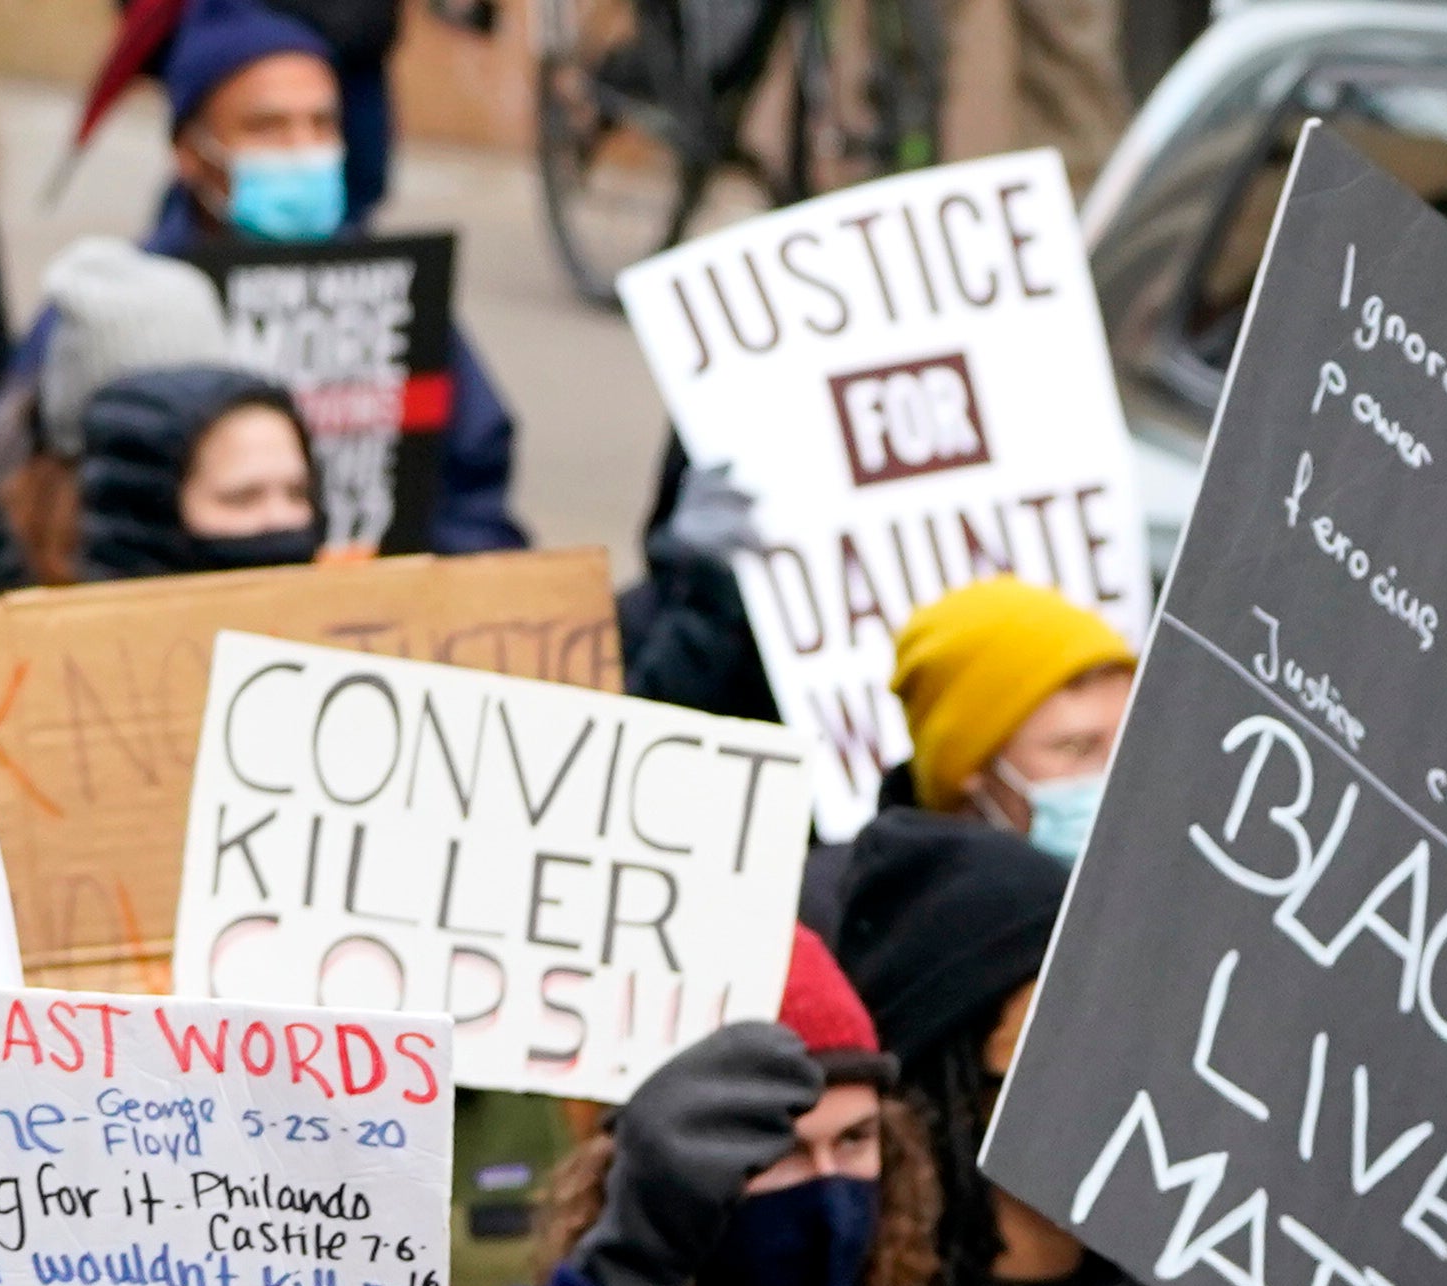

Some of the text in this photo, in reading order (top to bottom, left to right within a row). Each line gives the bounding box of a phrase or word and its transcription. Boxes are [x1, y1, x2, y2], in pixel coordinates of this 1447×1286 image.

[671, 180, 1056, 377] JUSTICE
[854, 377, 980, 472] FOR
[763, 481, 1125, 658] DAUNTE
[1251, 606, 1367, 749] Justice
[223, 660, 802, 873] CONVICT
[212, 804, 690, 973] KILLER
[153, 1007, 439, 1106] WORDS
[96, 1088, 215, 1129] George
[103, 1122, 202, 1164] Floyd
[36, 1162, 99, 1219] for
[190, 1171, 371, 1224] Philando
[205, 1213, 347, 1262] Castile
